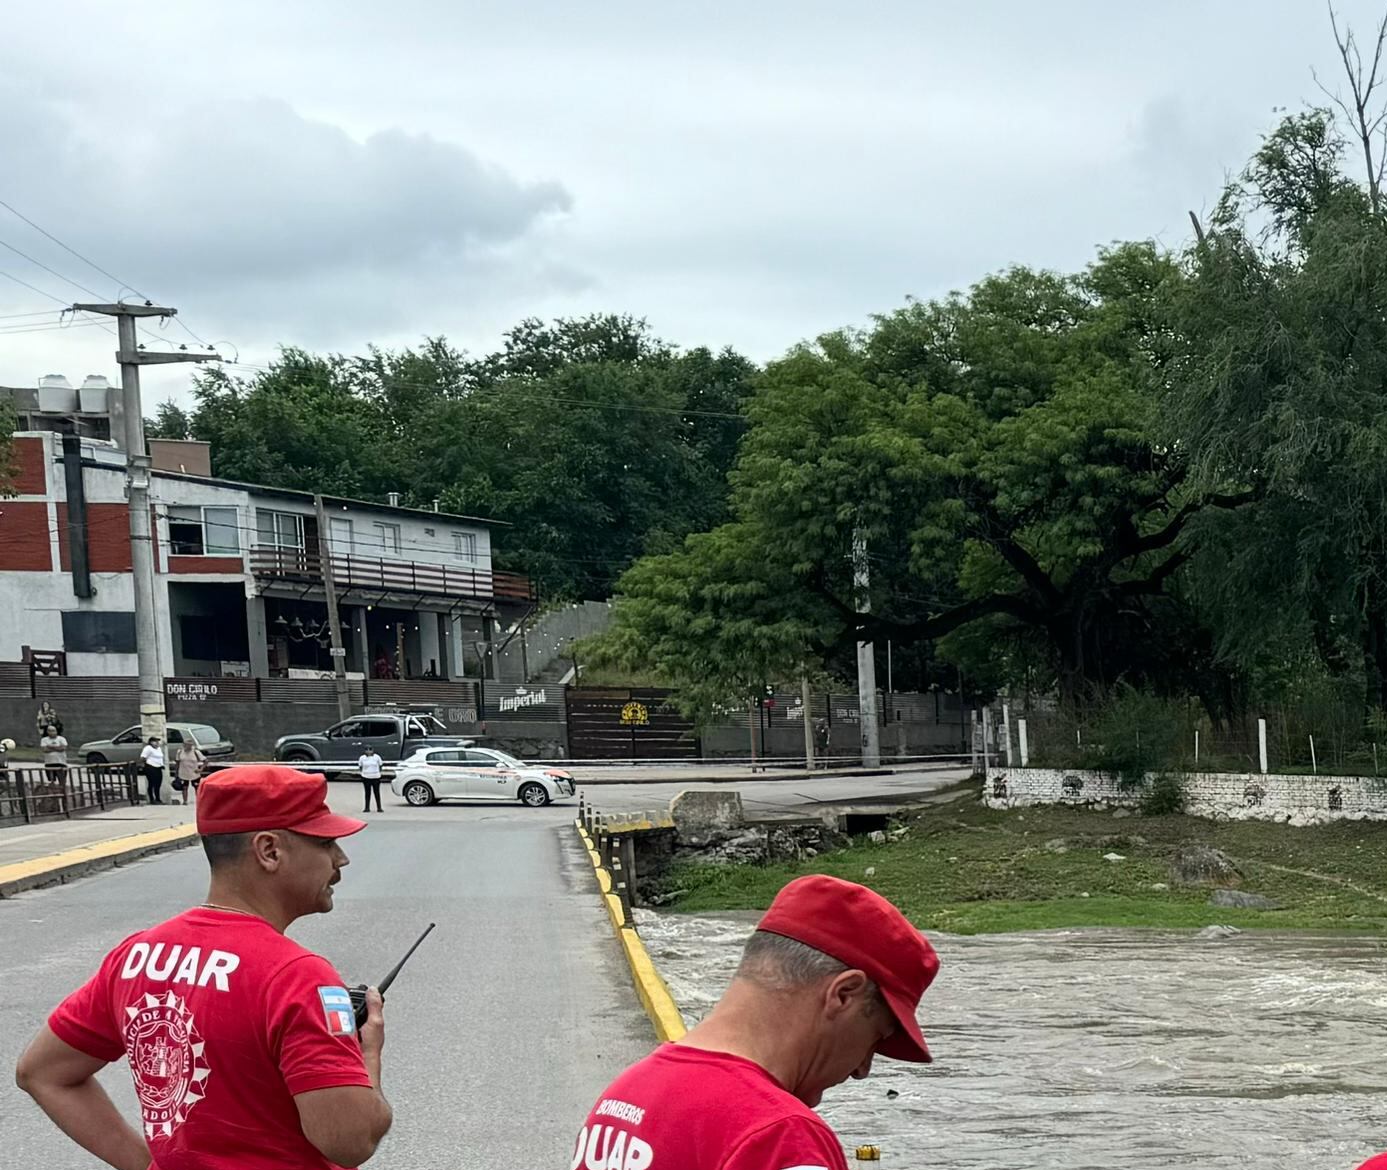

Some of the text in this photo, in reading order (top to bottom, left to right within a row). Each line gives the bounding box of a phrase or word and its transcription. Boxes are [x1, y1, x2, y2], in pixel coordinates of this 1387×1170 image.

[499, 689, 547, 712] Imperial
[121, 942, 240, 992] DUAR
[596, 1099, 645, 1125] BOMBEROS
